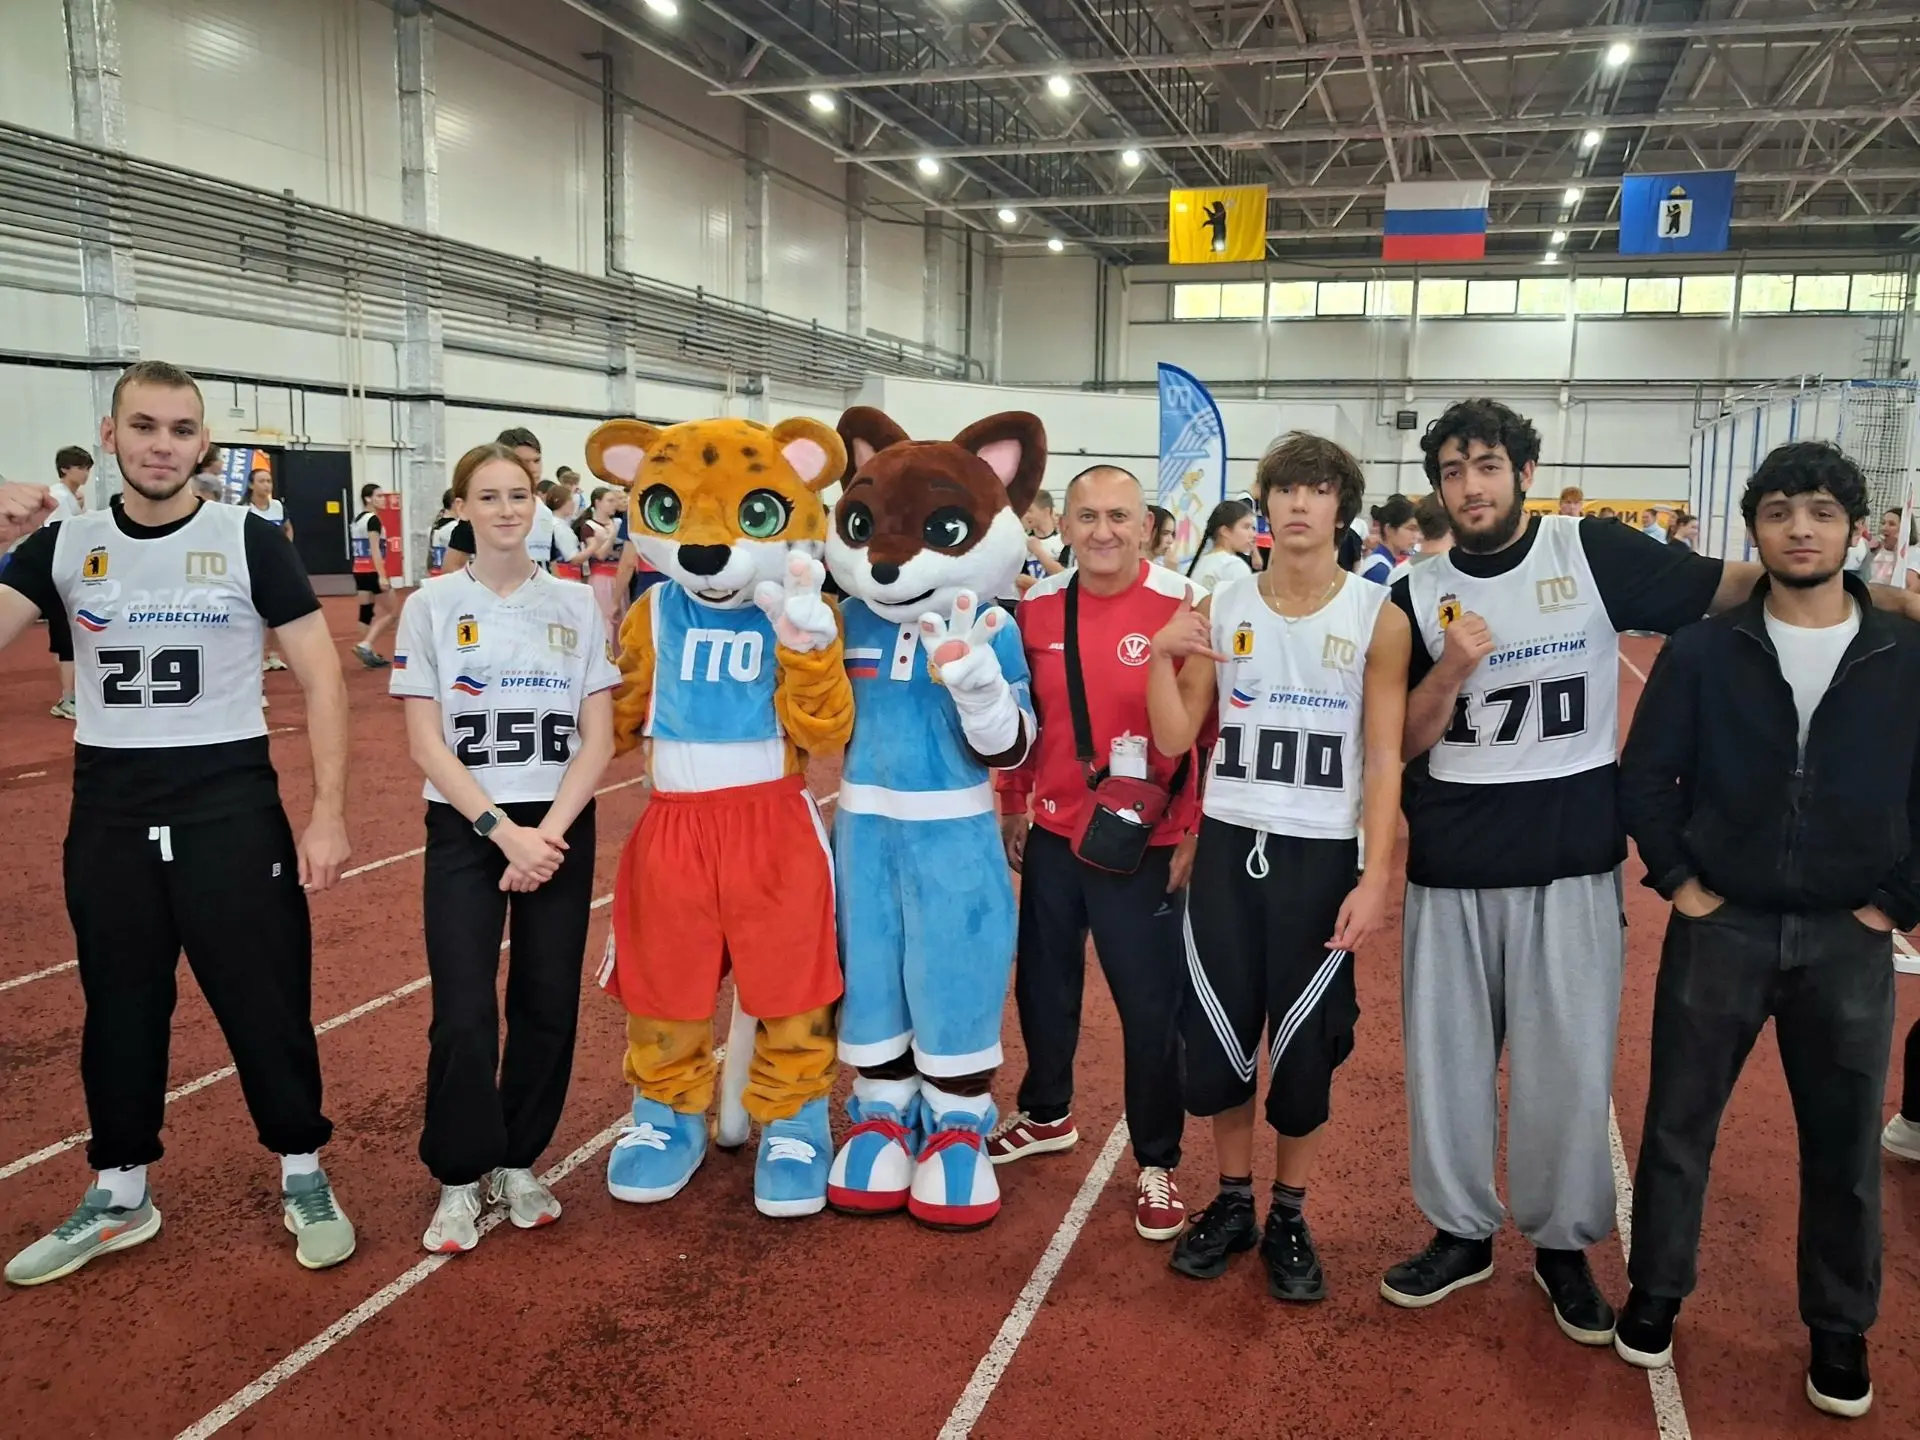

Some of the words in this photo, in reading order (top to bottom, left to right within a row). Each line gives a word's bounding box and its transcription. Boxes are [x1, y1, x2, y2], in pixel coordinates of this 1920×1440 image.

[128, 612, 230, 623] БУРЕВЕСТНИК
[95, 645, 204, 708] 29
[680, 628, 763, 682] ГТО
[1489, 638, 1587, 666] БУРЕВЕСТНИК
[1268, 693, 1349, 710] БУРЕВЕСТНИ
[1442, 672, 1588, 747] 170
[451, 708, 576, 770] 256
[1212, 722, 1347, 792] 100
[1041, 798, 1056, 814] 10
